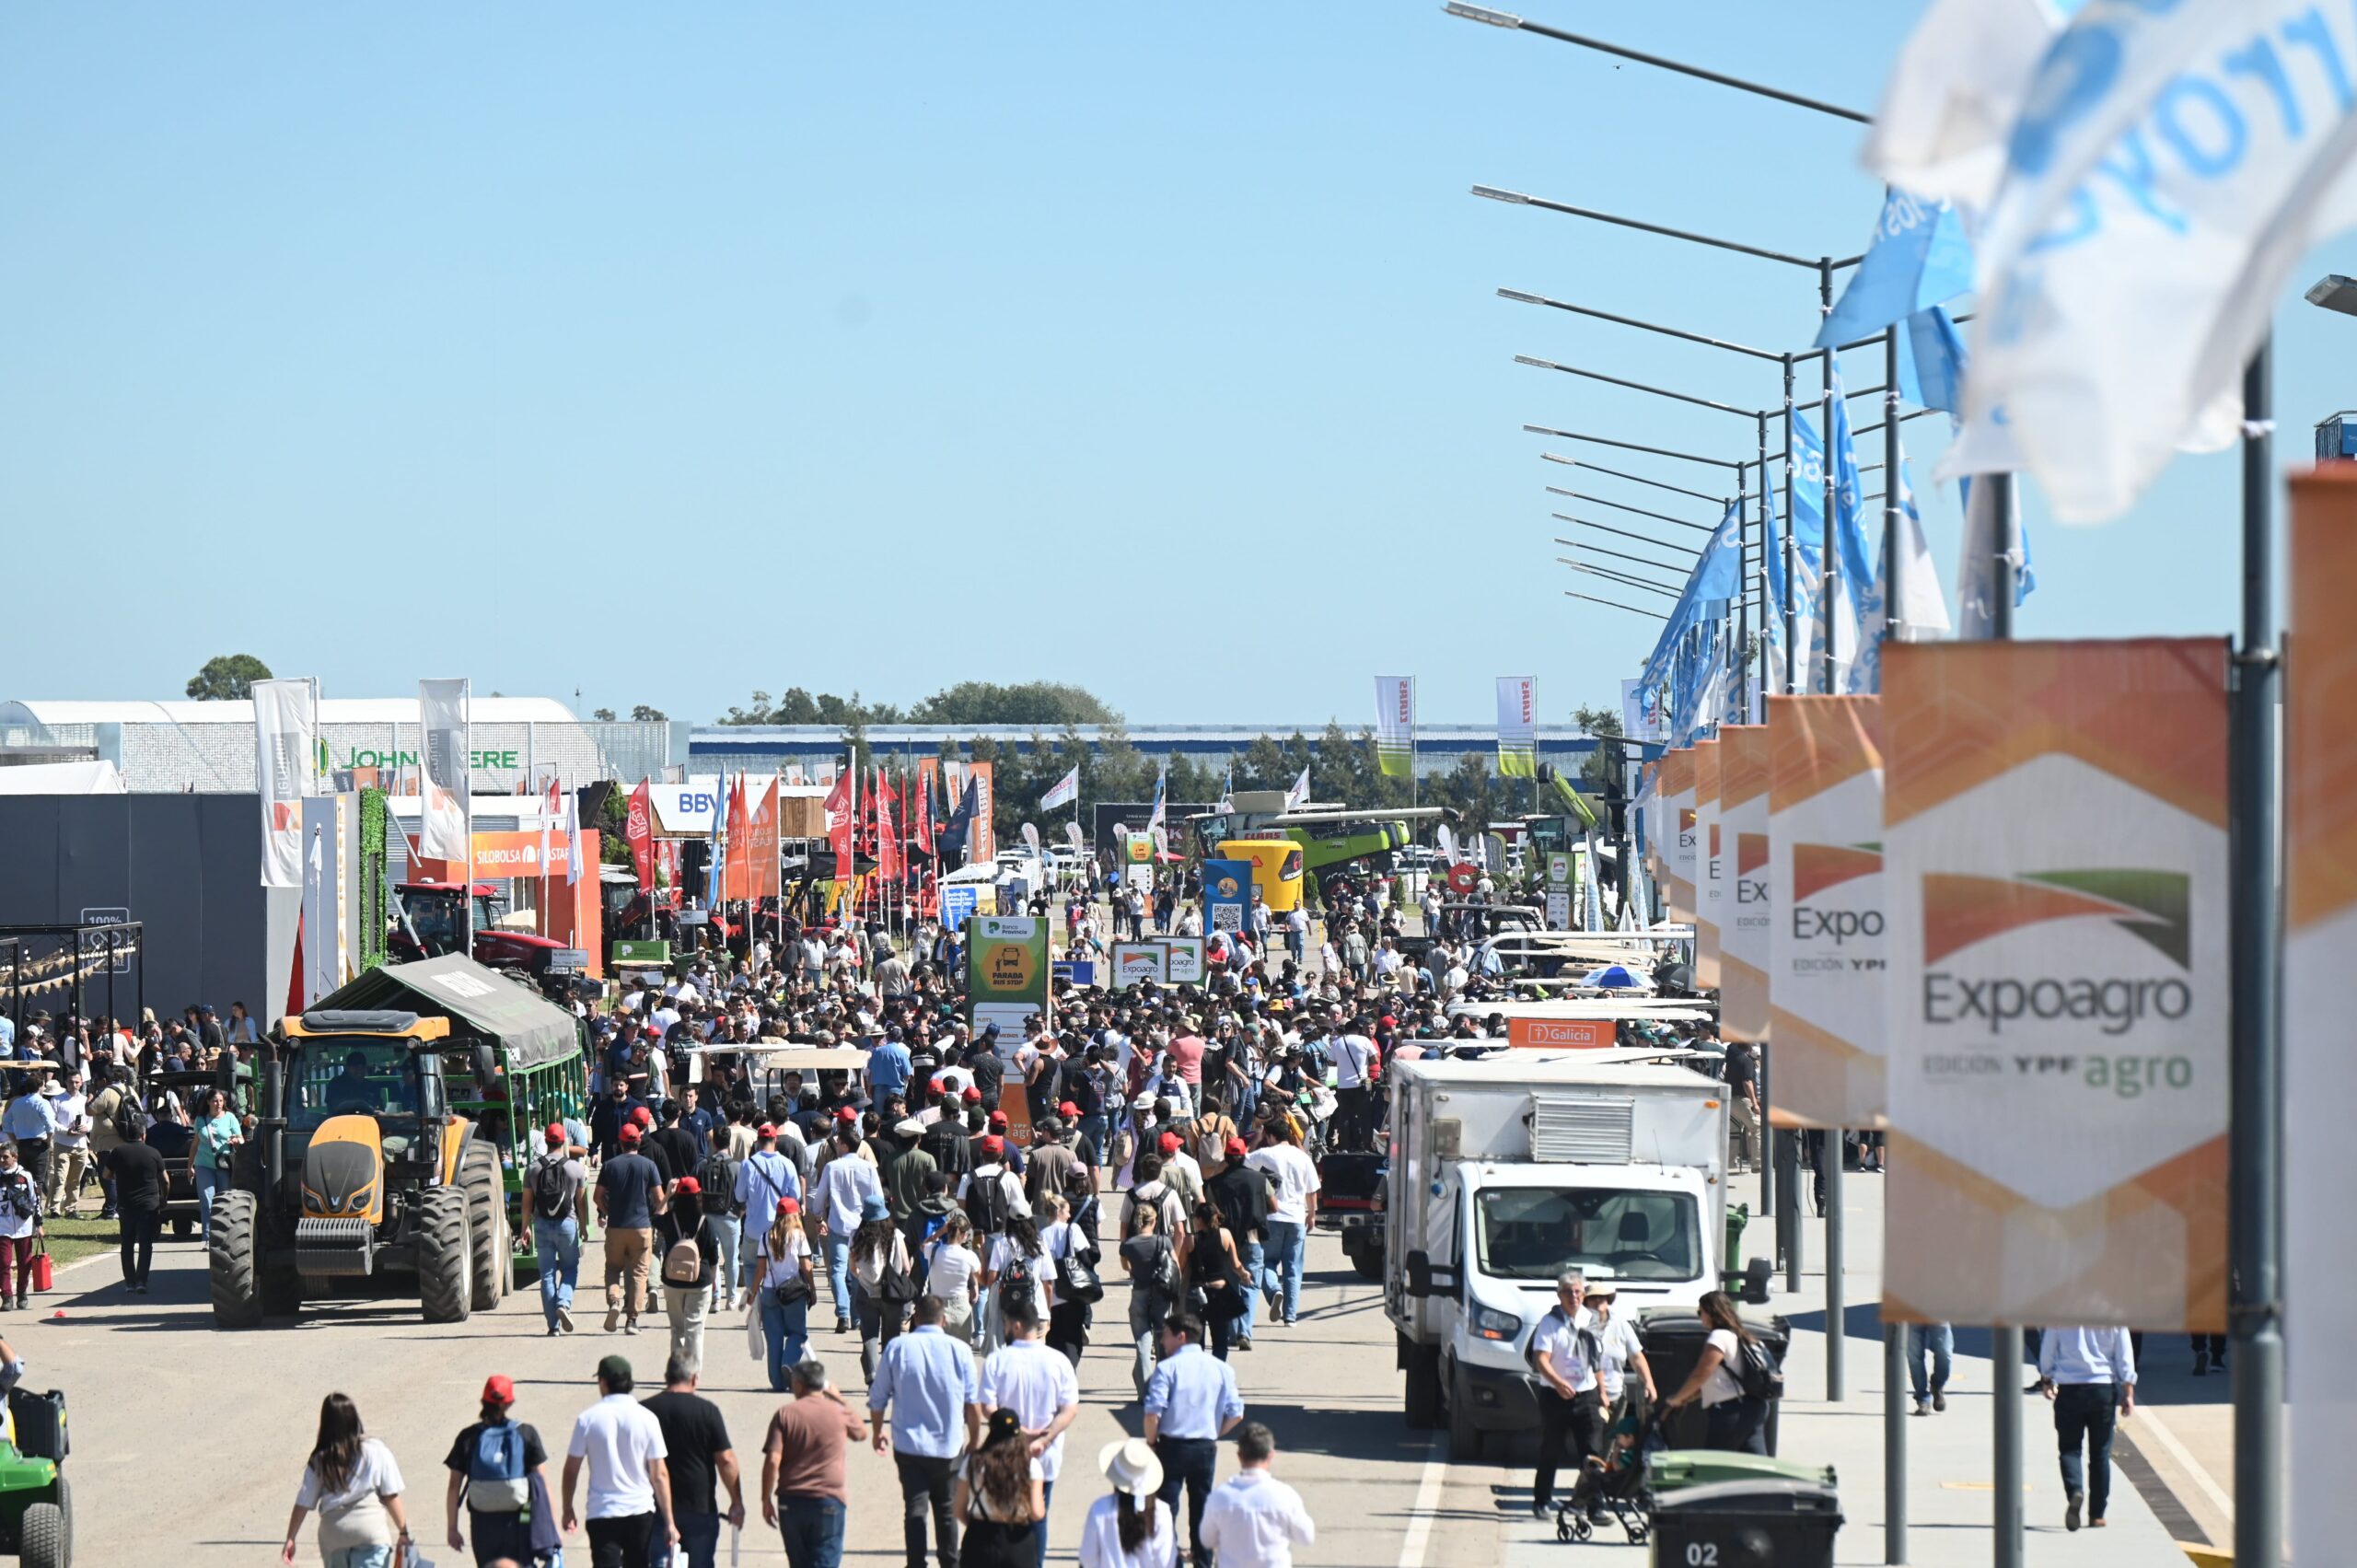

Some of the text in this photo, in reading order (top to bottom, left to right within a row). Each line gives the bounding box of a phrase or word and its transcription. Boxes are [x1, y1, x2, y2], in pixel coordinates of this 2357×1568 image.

[341, 747, 519, 769] JOHN ERE
[679, 793, 732, 813] BBV
[1244, 831, 1282, 841] CLAAS
[477, 849, 521, 865] SILOBOLSA
[1793, 907, 1886, 946] Expo
[1122, 965, 1158, 974] Expoagro
[1922, 971, 2192, 1036] Expoagro
[1550, 1028, 1591, 1040] Galicia
[2013, 1055, 2076, 1074] YPF
[2084, 1054, 2193, 1098] agro
[1013, 1128, 1031, 1139] agr
[1686, 1542, 1719, 1566] 02
